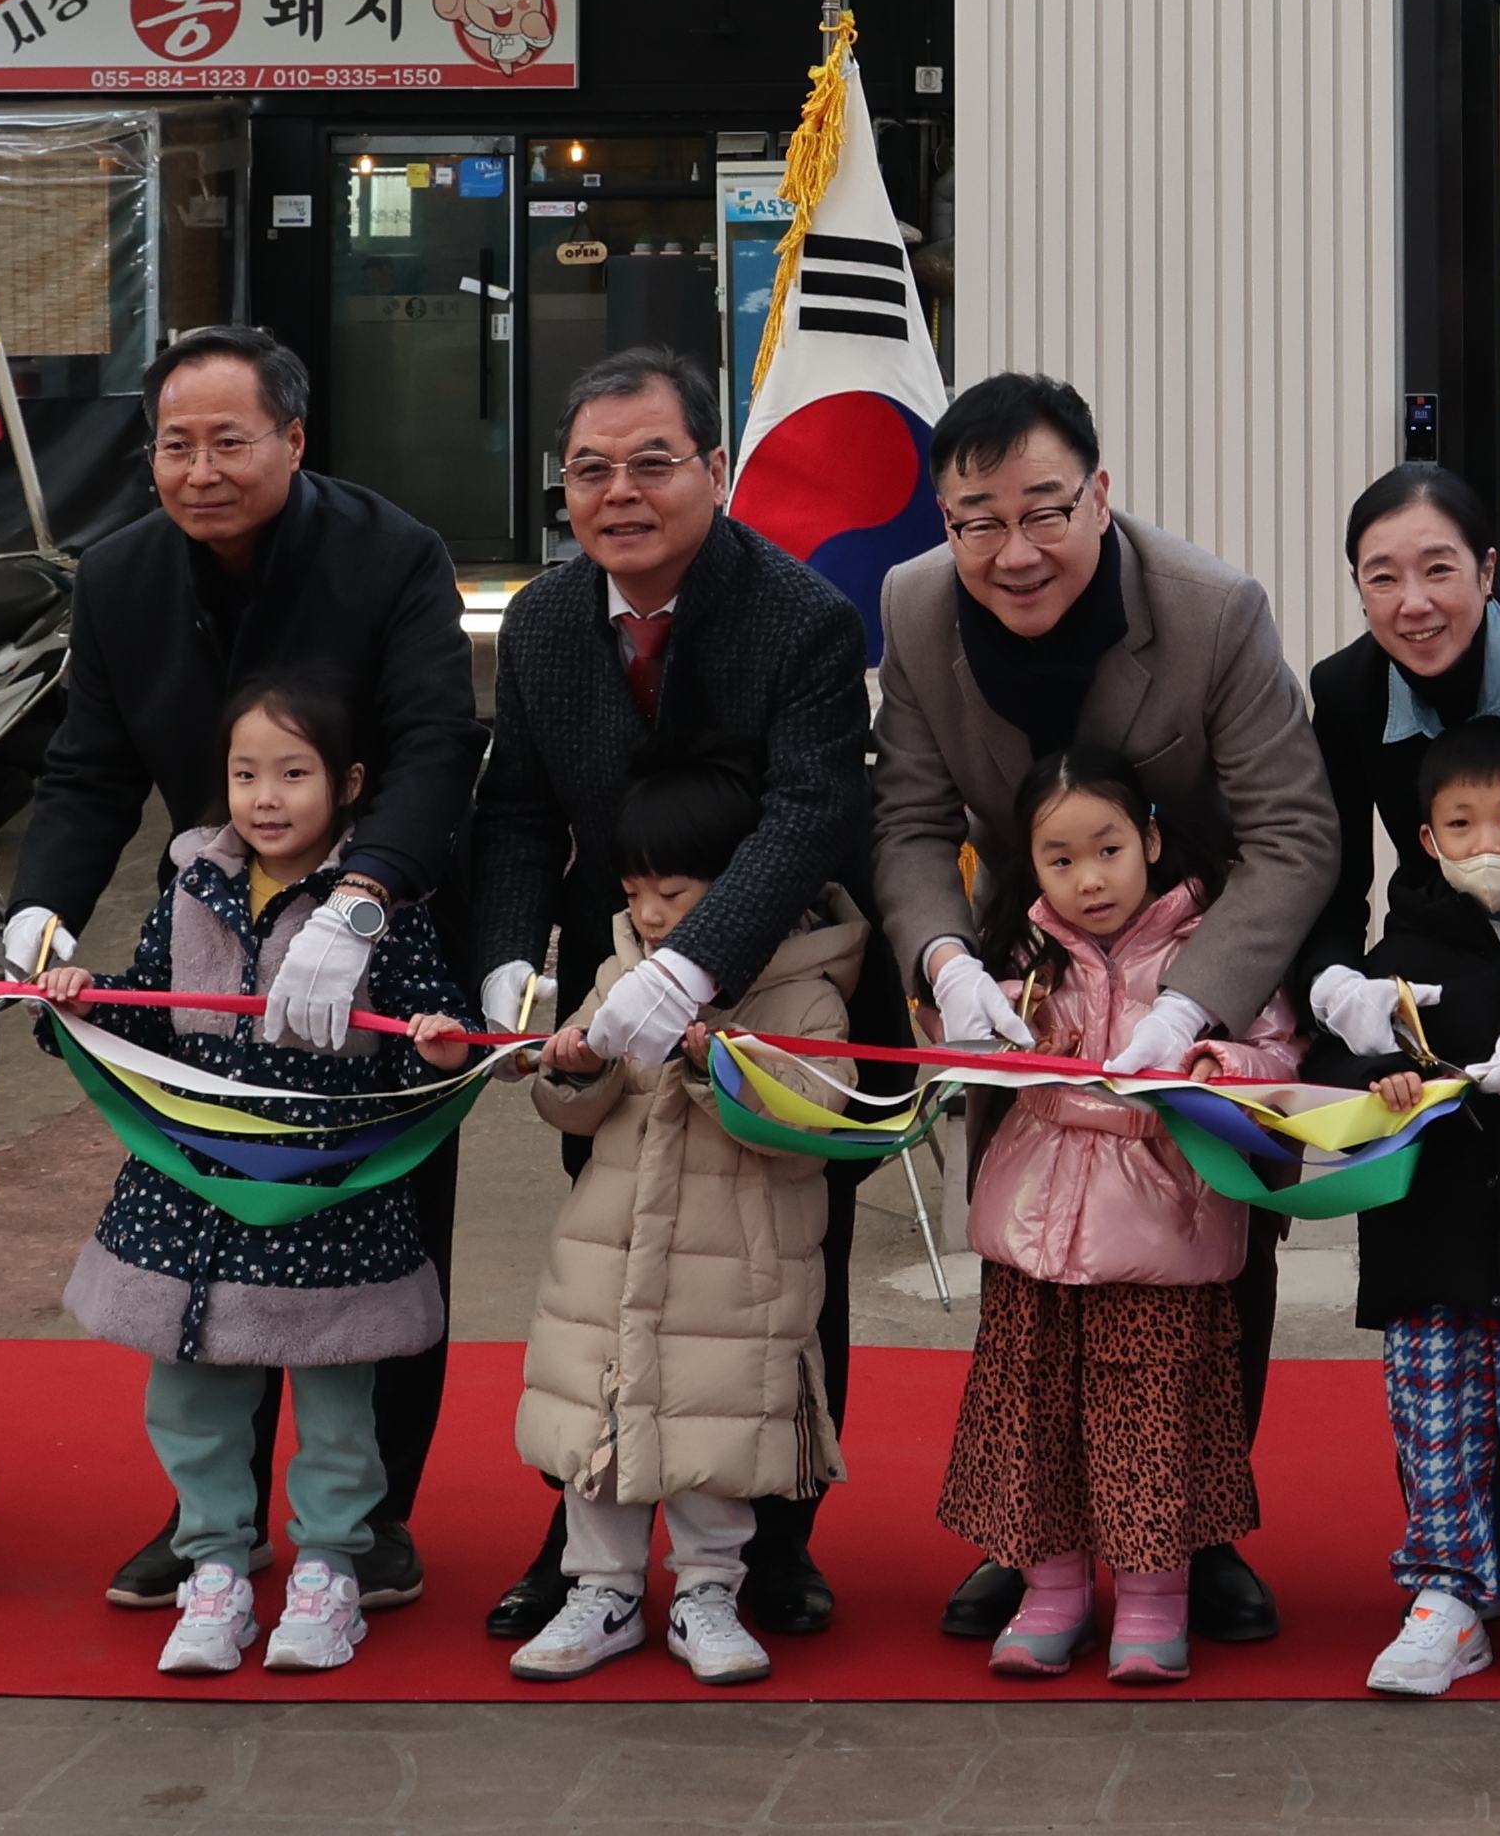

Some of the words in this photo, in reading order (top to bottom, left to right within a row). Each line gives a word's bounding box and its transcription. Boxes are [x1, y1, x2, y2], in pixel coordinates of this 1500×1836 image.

[91, 70, 246, 88] 055-884-1323
[273, 68, 442, 87] 010-9335-1550
[565, 247, 599, 258] OPEN
